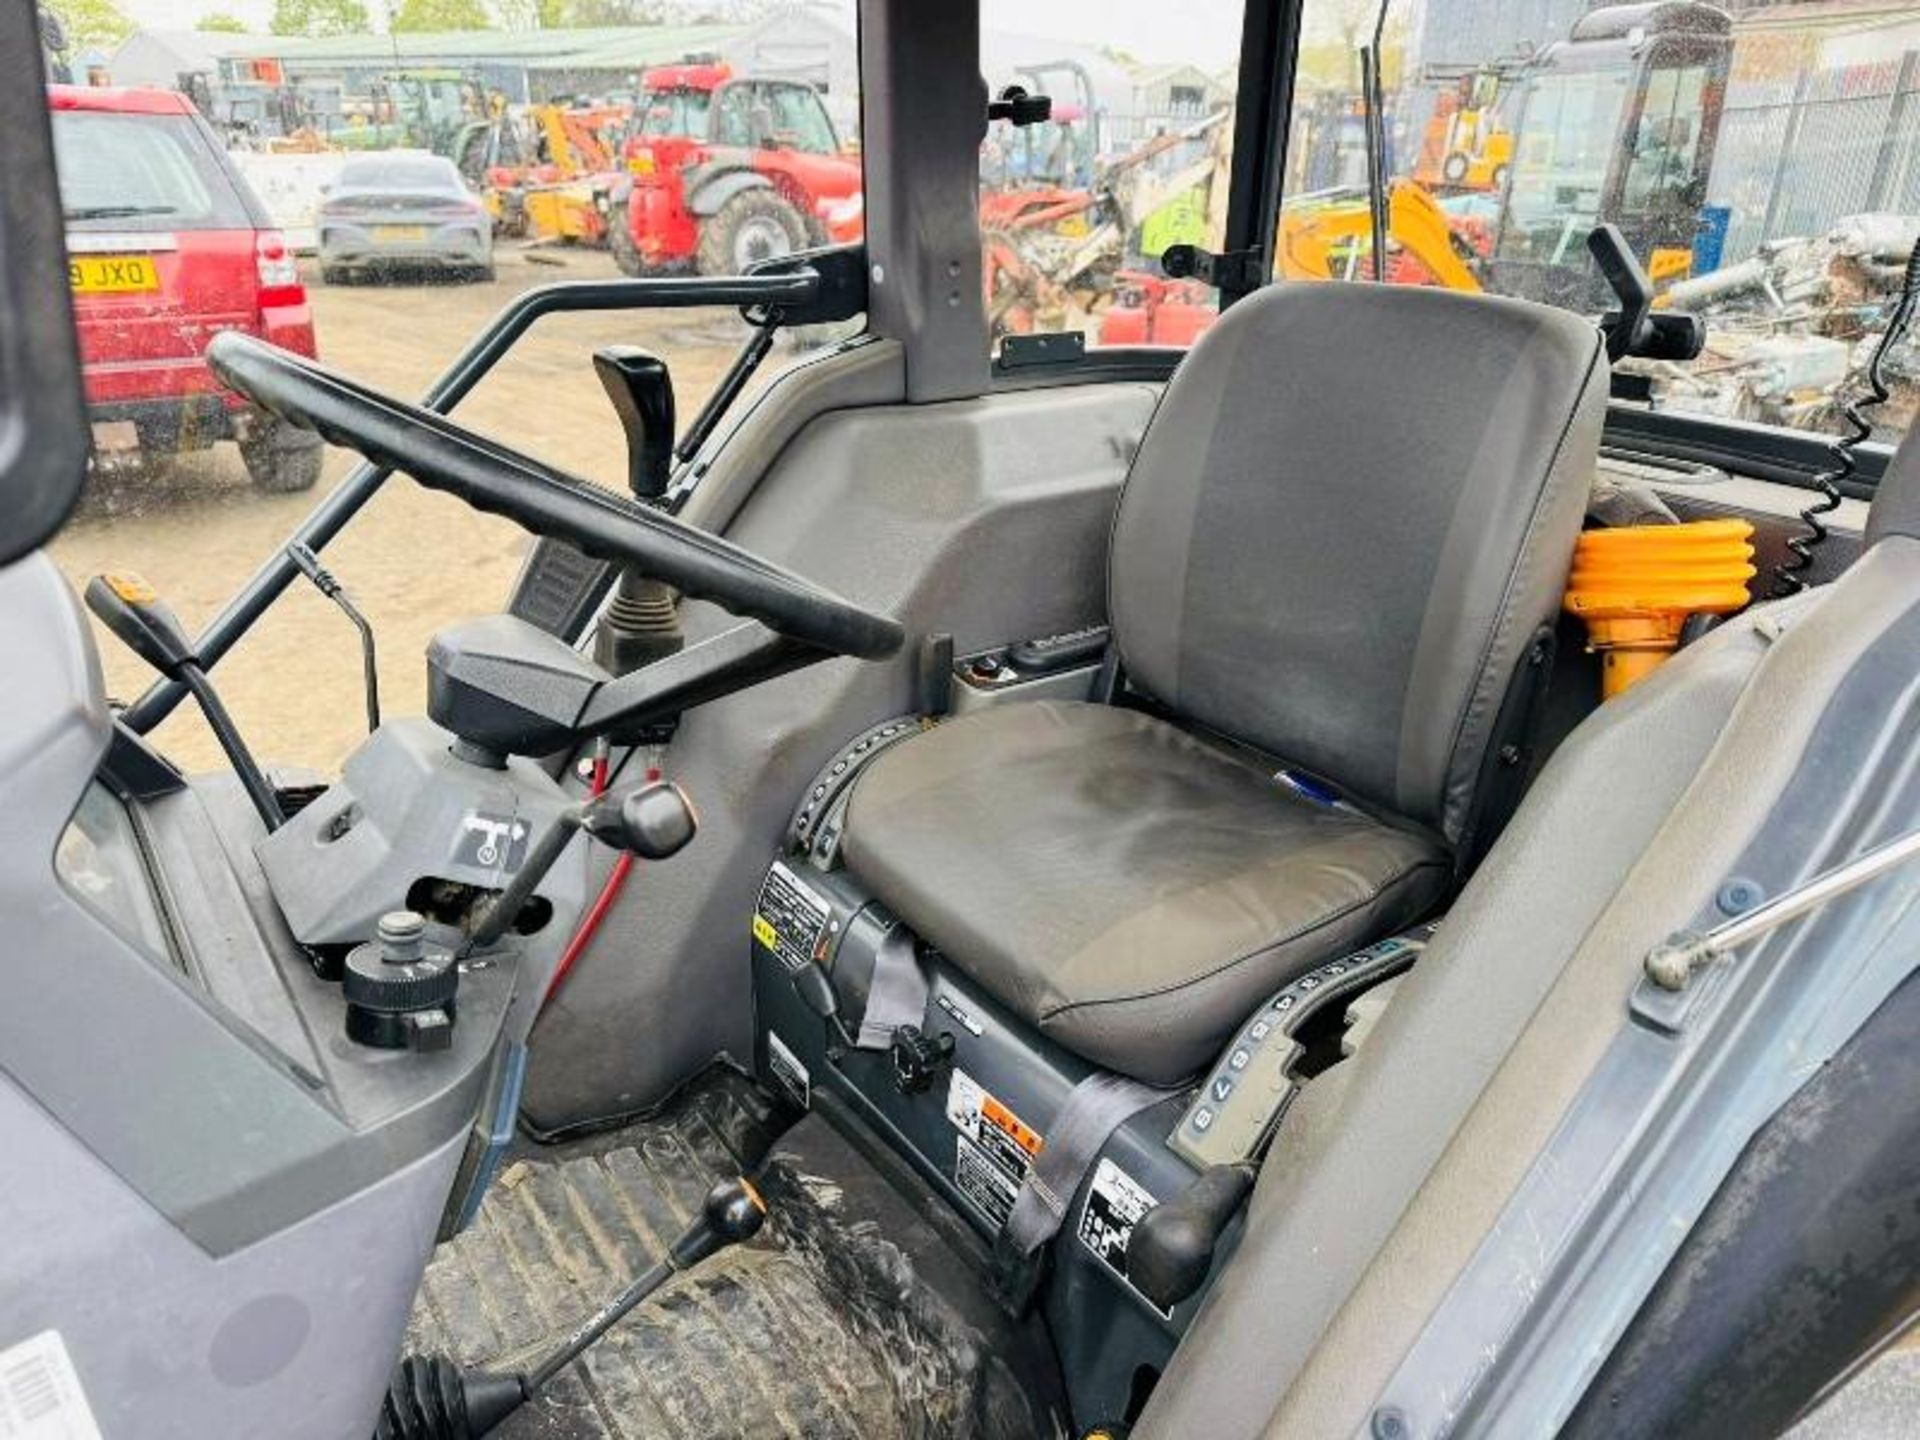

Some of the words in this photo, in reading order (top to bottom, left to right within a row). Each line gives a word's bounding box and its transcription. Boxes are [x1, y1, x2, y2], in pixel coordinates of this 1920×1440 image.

[1276, 995, 1293, 1010] 4
[1215, 1082, 1231, 1100] 7
[1194, 1108, 1213, 1129] 8
